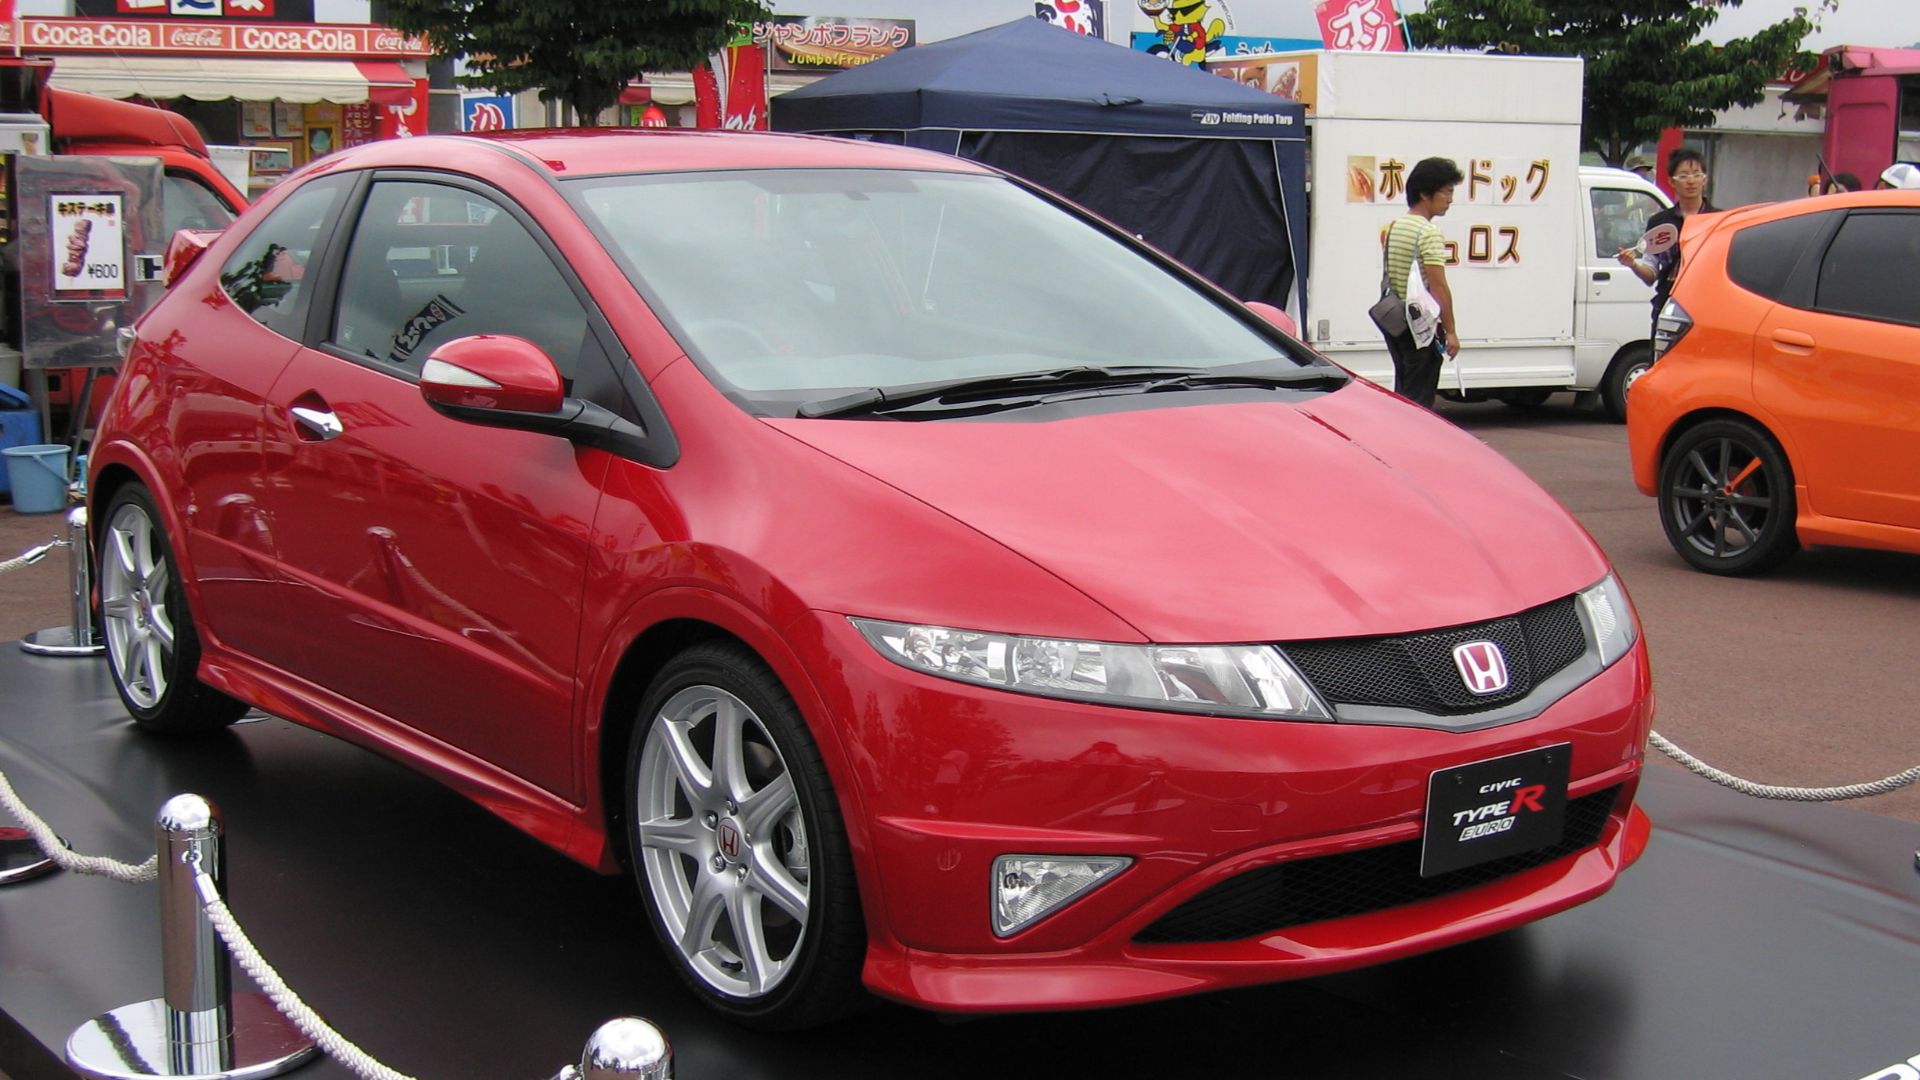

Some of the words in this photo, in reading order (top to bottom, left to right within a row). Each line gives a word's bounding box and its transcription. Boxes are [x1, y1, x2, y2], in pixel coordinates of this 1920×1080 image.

[32, 22, 151, 46] Coca-Cola
[243, 27, 357, 50] Coca-Cola
[752, 21, 909, 48] ジャンボフランク
[1222, 112, 1252, 125] Folding
[1253, 113, 1274, 124] Patio
[1275, 114, 1294, 125] Tarp
[87, 263, 119, 279] ¥600
[1479, 777, 1522, 794] CIVIC
[1452, 800, 1511, 827] TYPE
[1508, 784, 1547, 814] R
[1458, 816, 1516, 842] EURO
